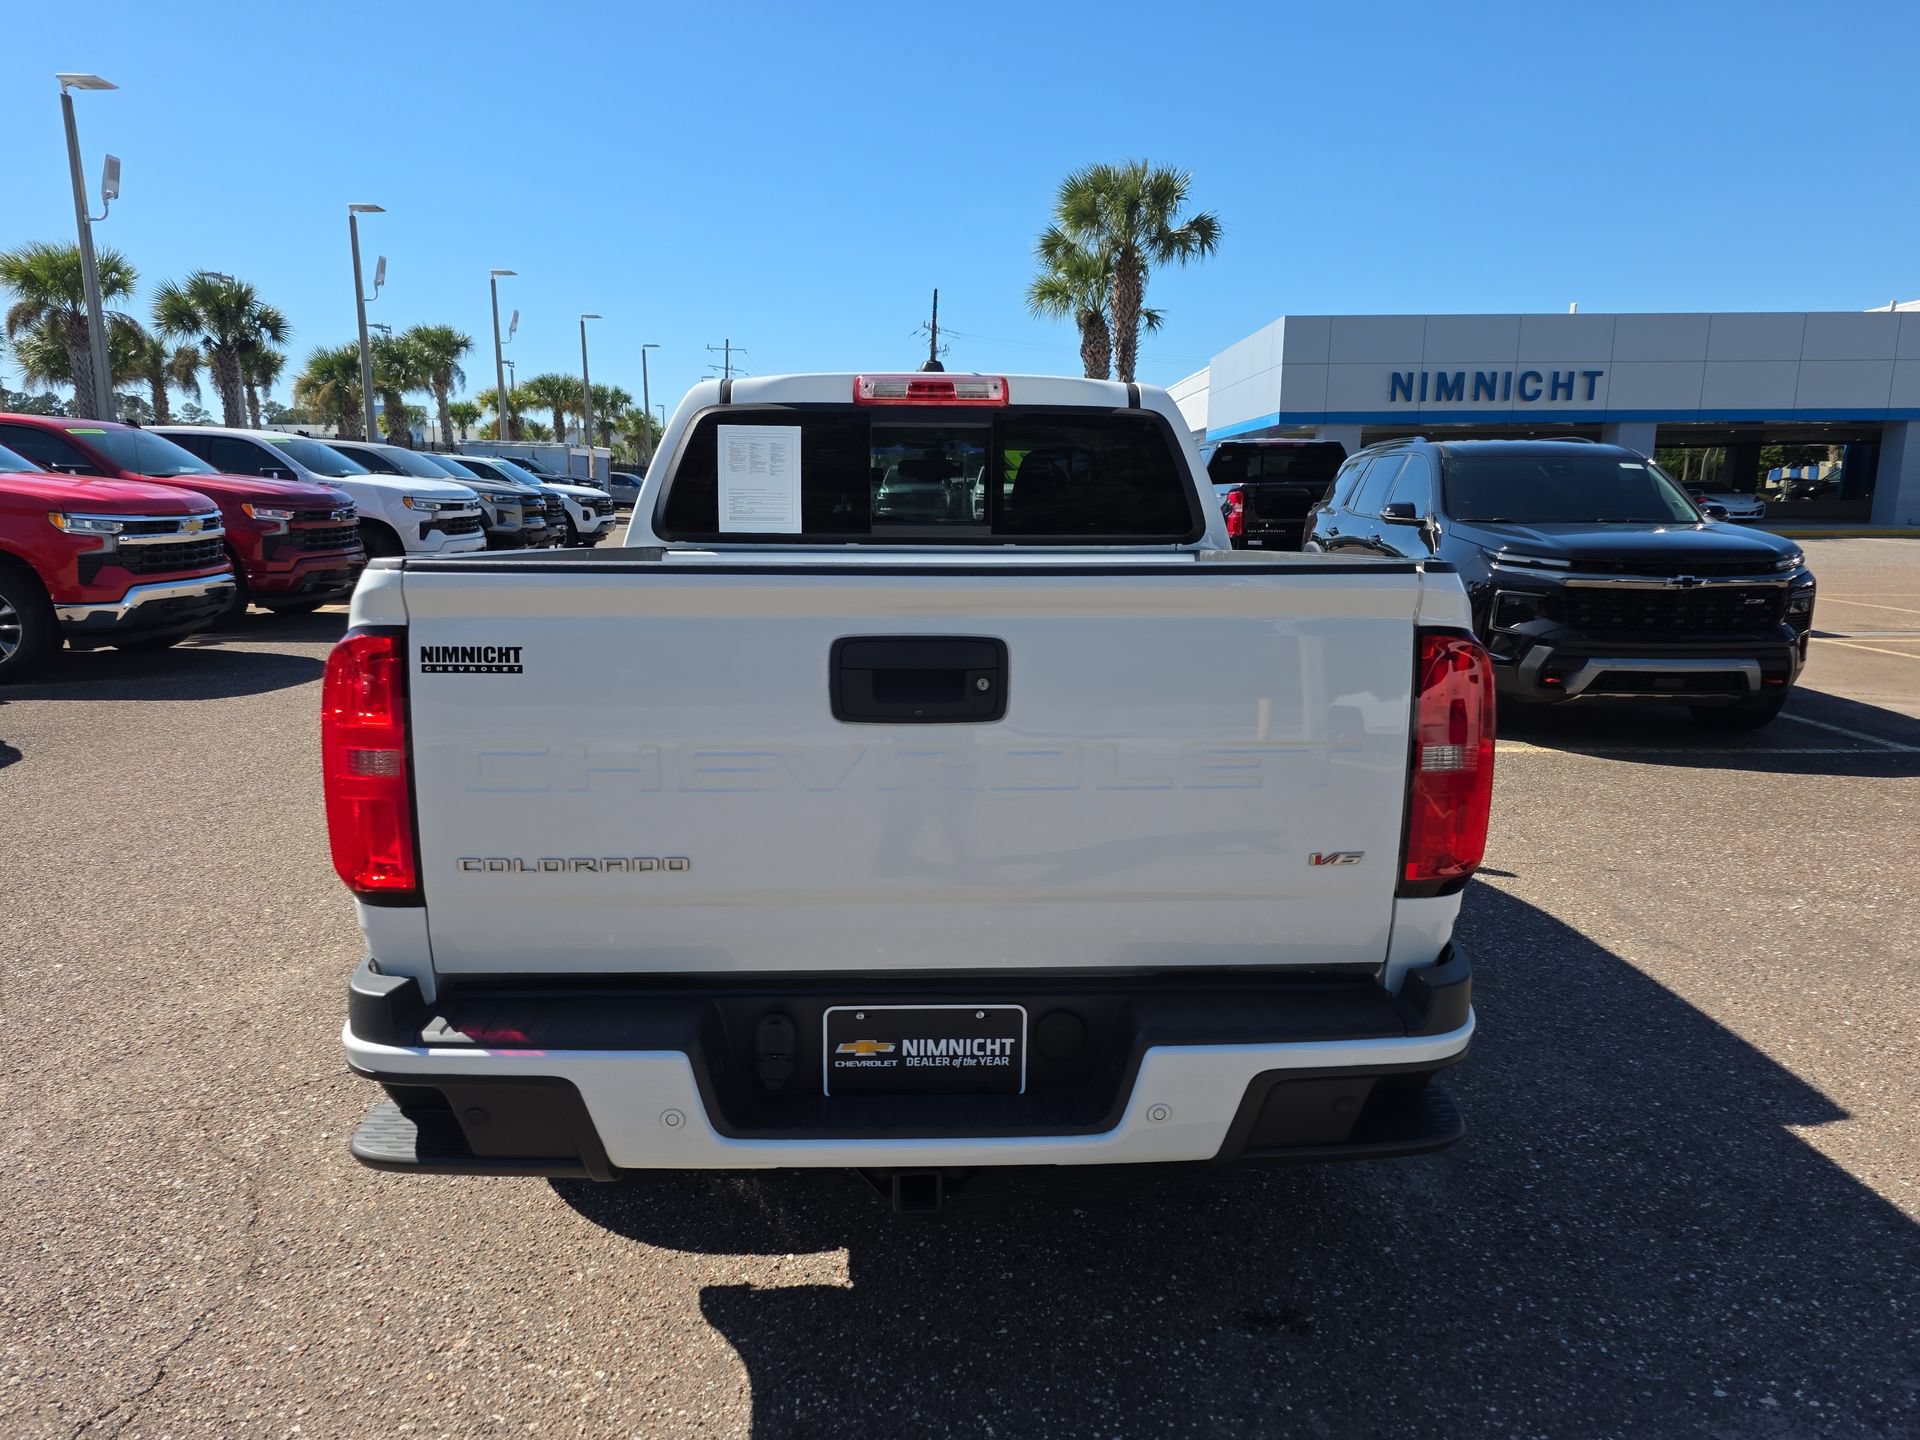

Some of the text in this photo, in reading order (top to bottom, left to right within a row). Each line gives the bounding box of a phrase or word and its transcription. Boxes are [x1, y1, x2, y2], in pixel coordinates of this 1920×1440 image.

[1390, 371, 1604, 402] NIMNICHT
[421, 646, 523, 664] NIMNICHT
[465, 743, 1361, 792] CHEVROLET
[457, 857, 690, 873] COLORADO
[1309, 851, 1365, 866] V6
[902, 1038, 1015, 1056] NIMNICHT
[906, 1057, 1010, 1069] DEALER of the YEAR
